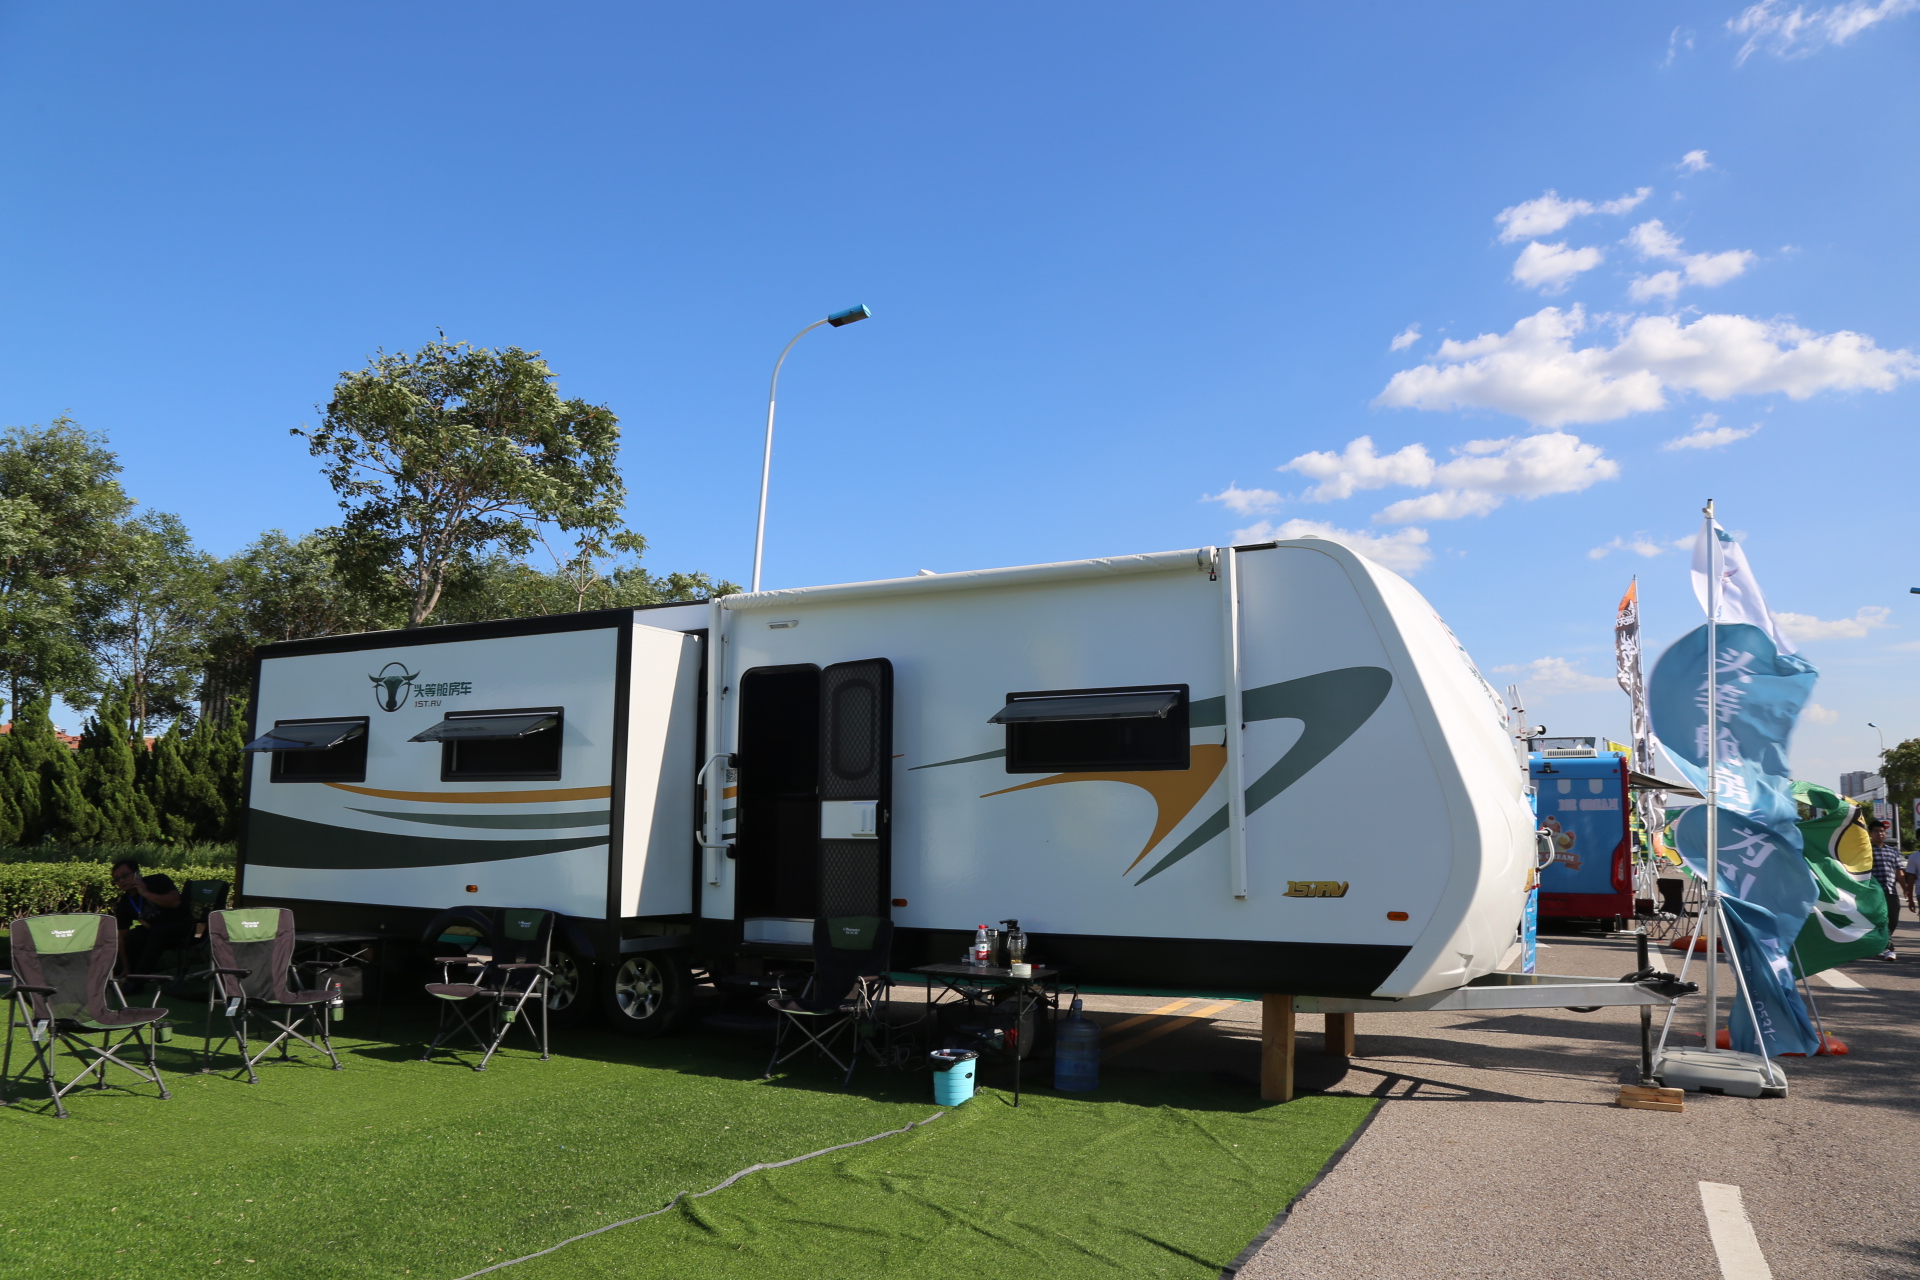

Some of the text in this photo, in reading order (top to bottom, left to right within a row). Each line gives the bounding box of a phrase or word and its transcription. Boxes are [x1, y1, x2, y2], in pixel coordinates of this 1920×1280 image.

[413, 681, 473, 698] 头等舱房车
[1558, 798, 1619, 811] ICE CREAM
[1545, 853, 1575, 862] CEAM
